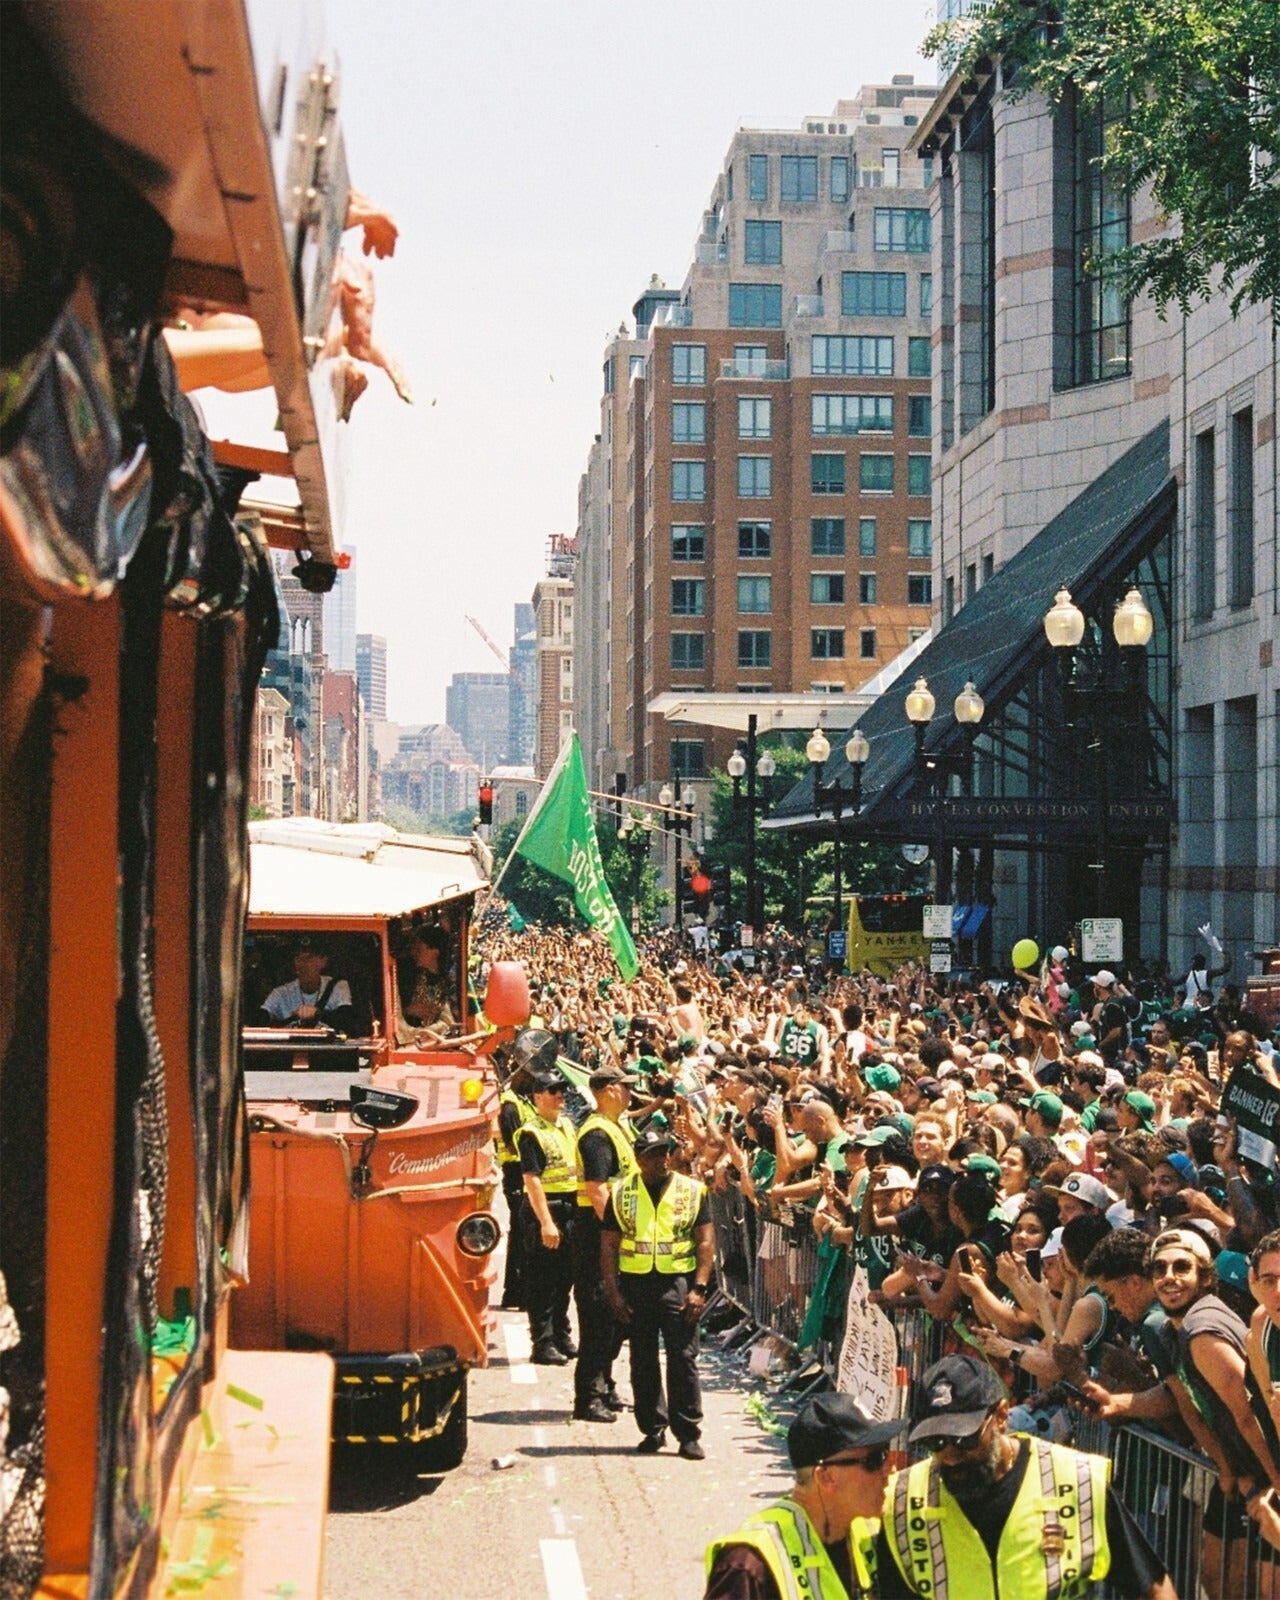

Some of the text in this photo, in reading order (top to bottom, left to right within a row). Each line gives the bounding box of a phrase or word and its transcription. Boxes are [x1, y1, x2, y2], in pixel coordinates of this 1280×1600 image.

[911, 804, 1166, 817] HYES CONVENTION ENTER
[785, 1033, 813, 1056] 36
[1229, 1084, 1280, 1128] BANNER 18
[910, 1496, 932, 1600] BOSTO
